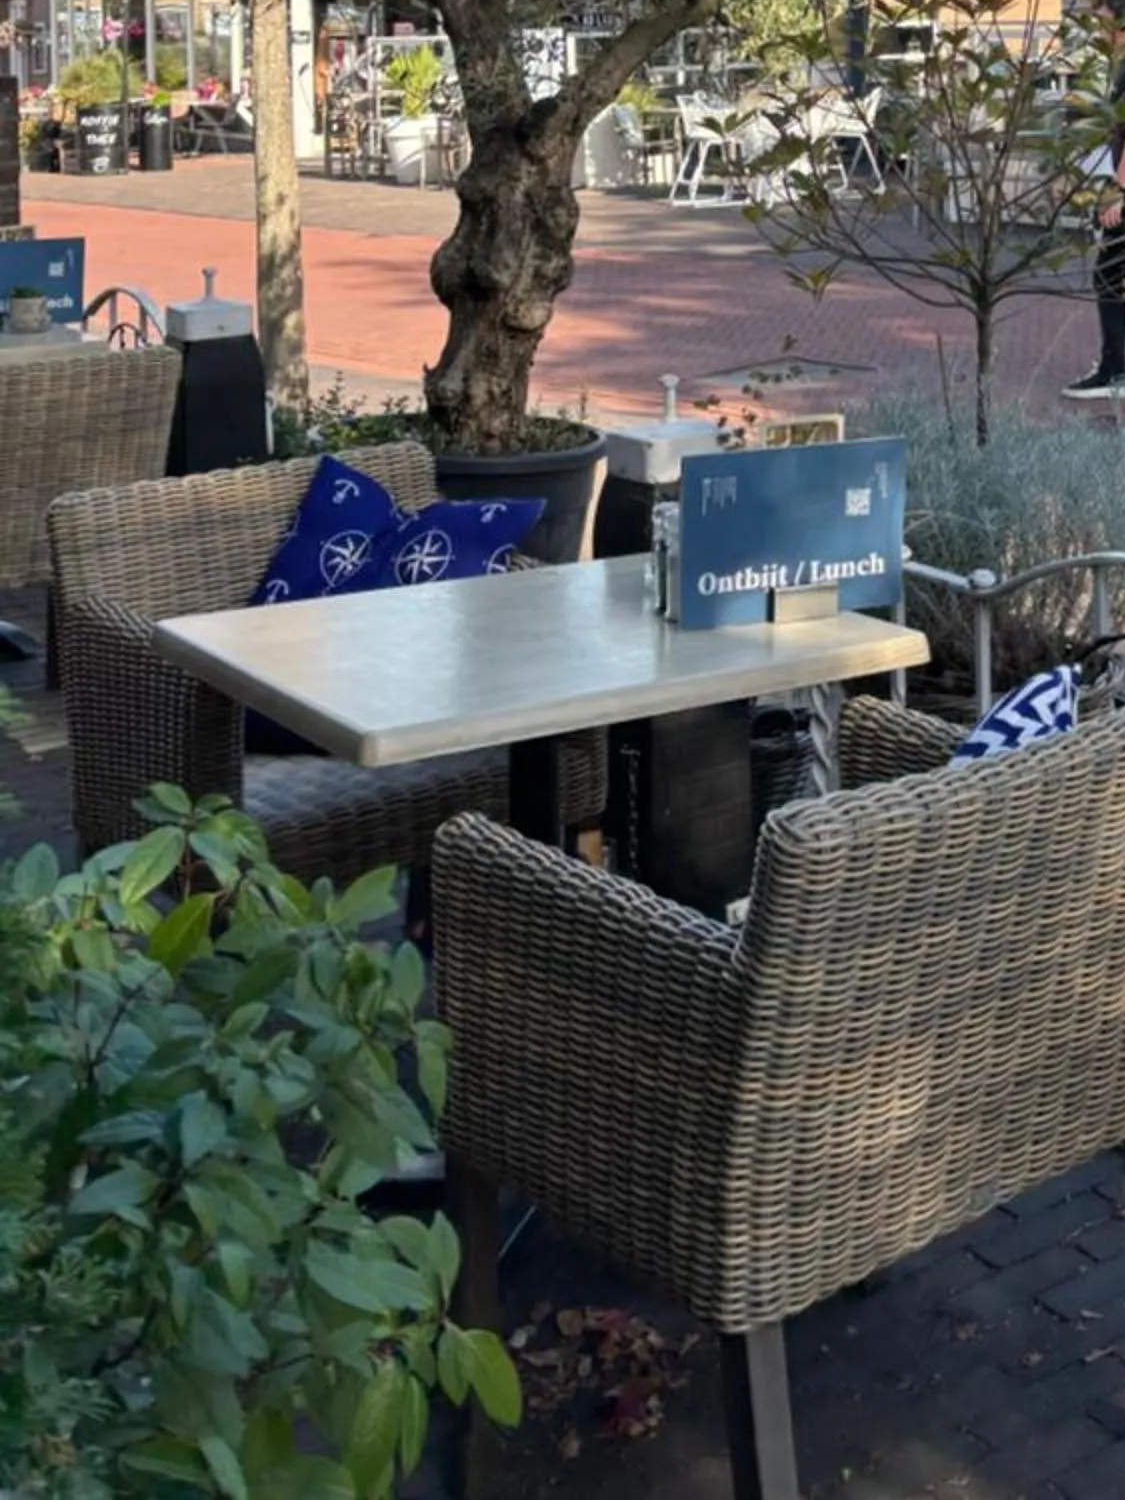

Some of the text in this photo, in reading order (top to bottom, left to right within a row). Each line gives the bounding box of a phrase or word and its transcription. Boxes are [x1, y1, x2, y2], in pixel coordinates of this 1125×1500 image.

[698, 552, 885, 596] Ontbijt / Lunch
